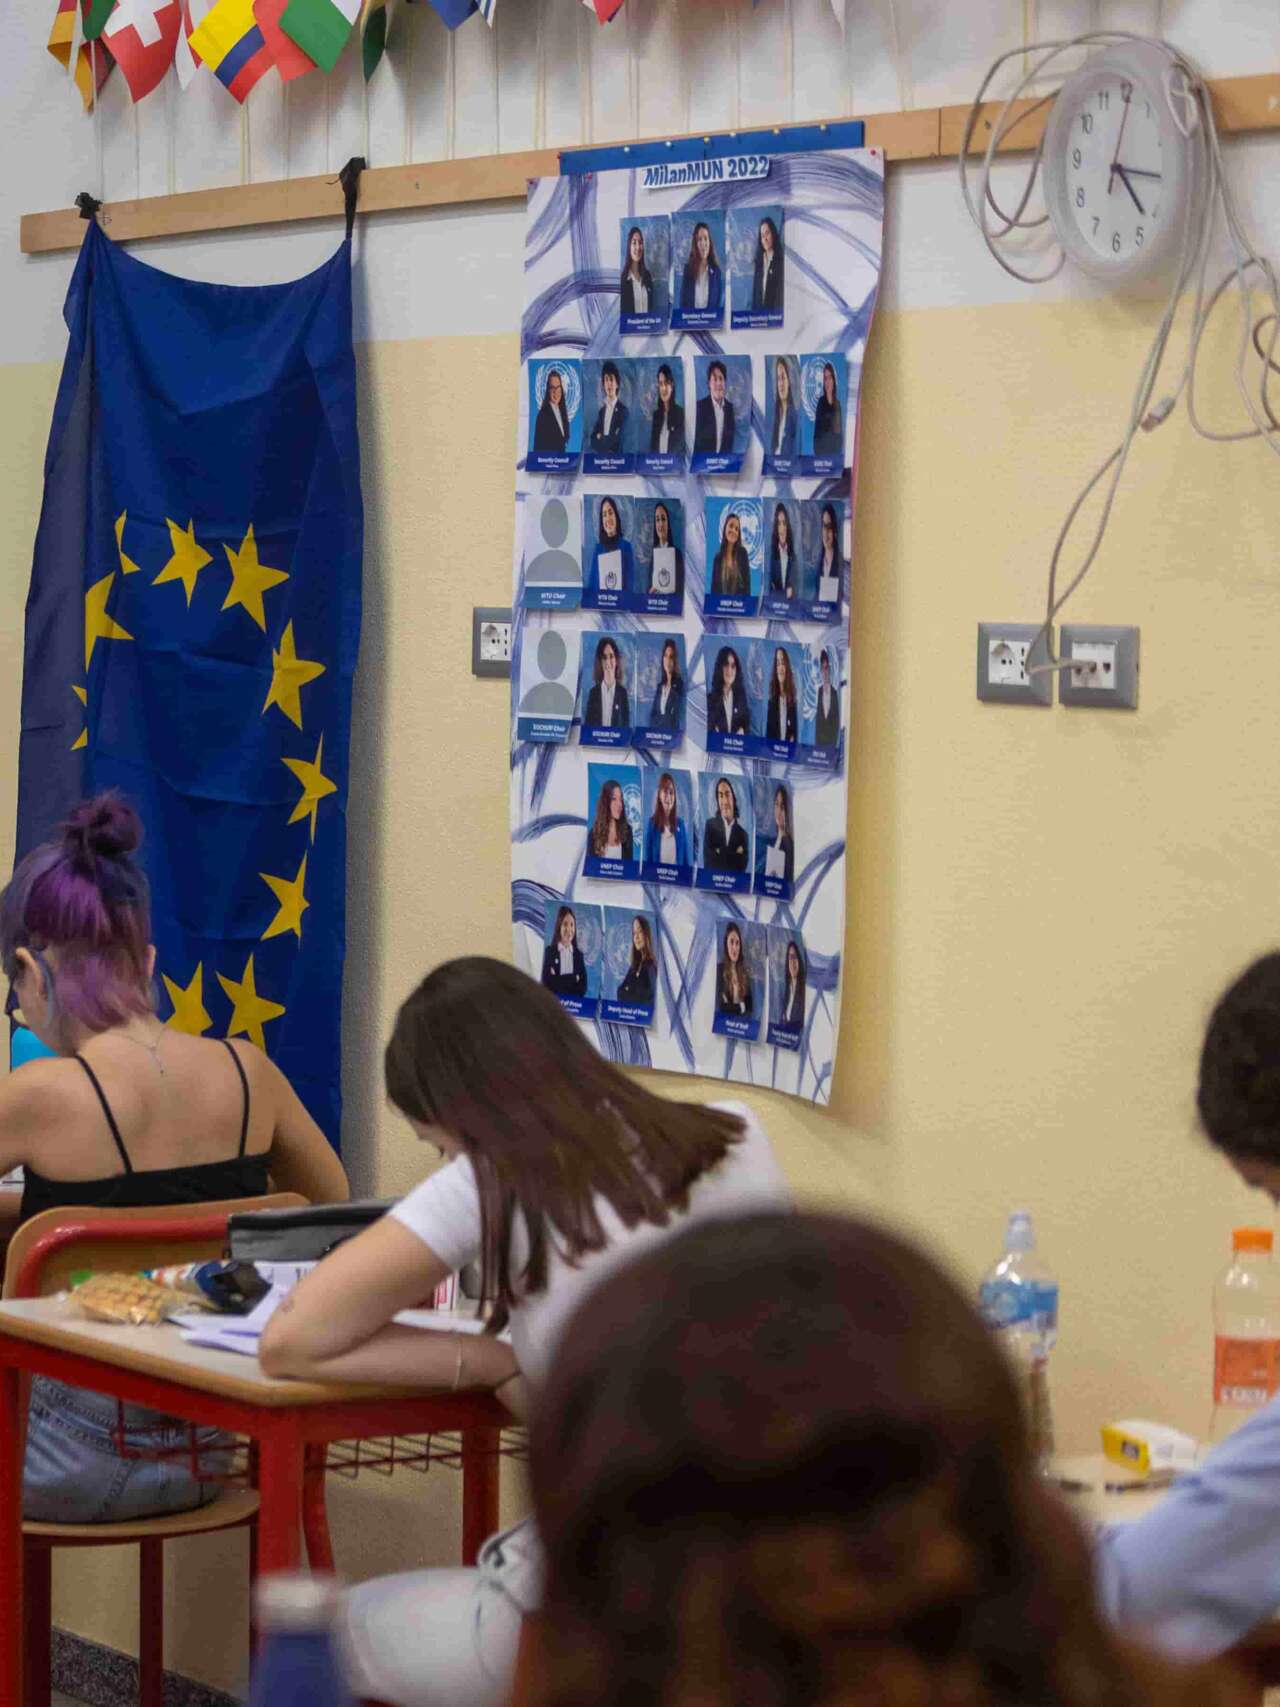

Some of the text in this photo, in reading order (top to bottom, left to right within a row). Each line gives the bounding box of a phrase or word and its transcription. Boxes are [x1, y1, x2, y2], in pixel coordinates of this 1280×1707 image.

[1098, 90, 1110, 111] 11
[1080, 112, 1094, 135] 10
[1072, 148, 1082, 170] 9
[644, 155, 769, 186] MilanMUN 2022
[1076, 187, 1086, 208] 8
[1092, 216, 1101, 237] 7
[1135, 226, 1145, 247] 5
[1112, 232, 1121, 253] 6
